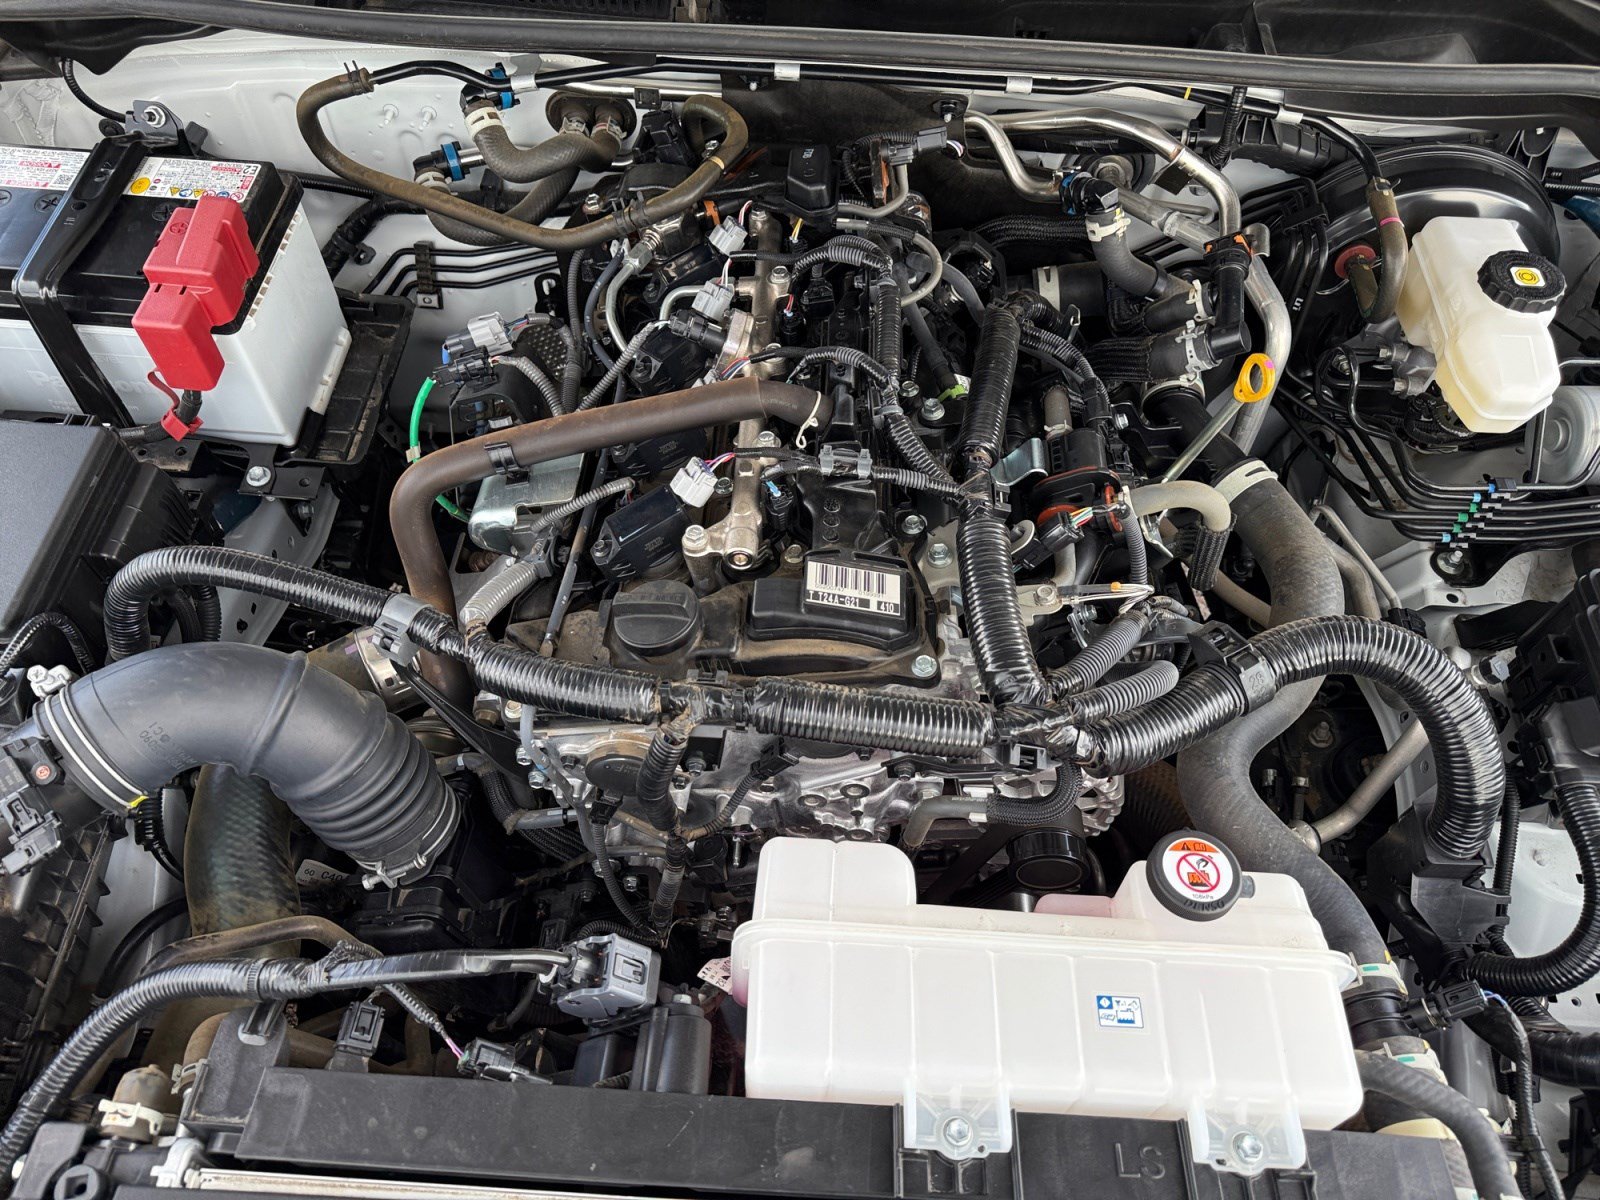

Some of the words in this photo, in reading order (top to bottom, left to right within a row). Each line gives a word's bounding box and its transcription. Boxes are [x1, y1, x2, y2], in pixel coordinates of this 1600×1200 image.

[243, 166, 259, 175] E2
[808, 590, 814, 600] T
[818, 591, 860, 608] T24A-G21
[880, 602, 895, 613] 410
[1183, 899, 1225, 911] DENSO
[1114, 1142, 1166, 1180] LS
